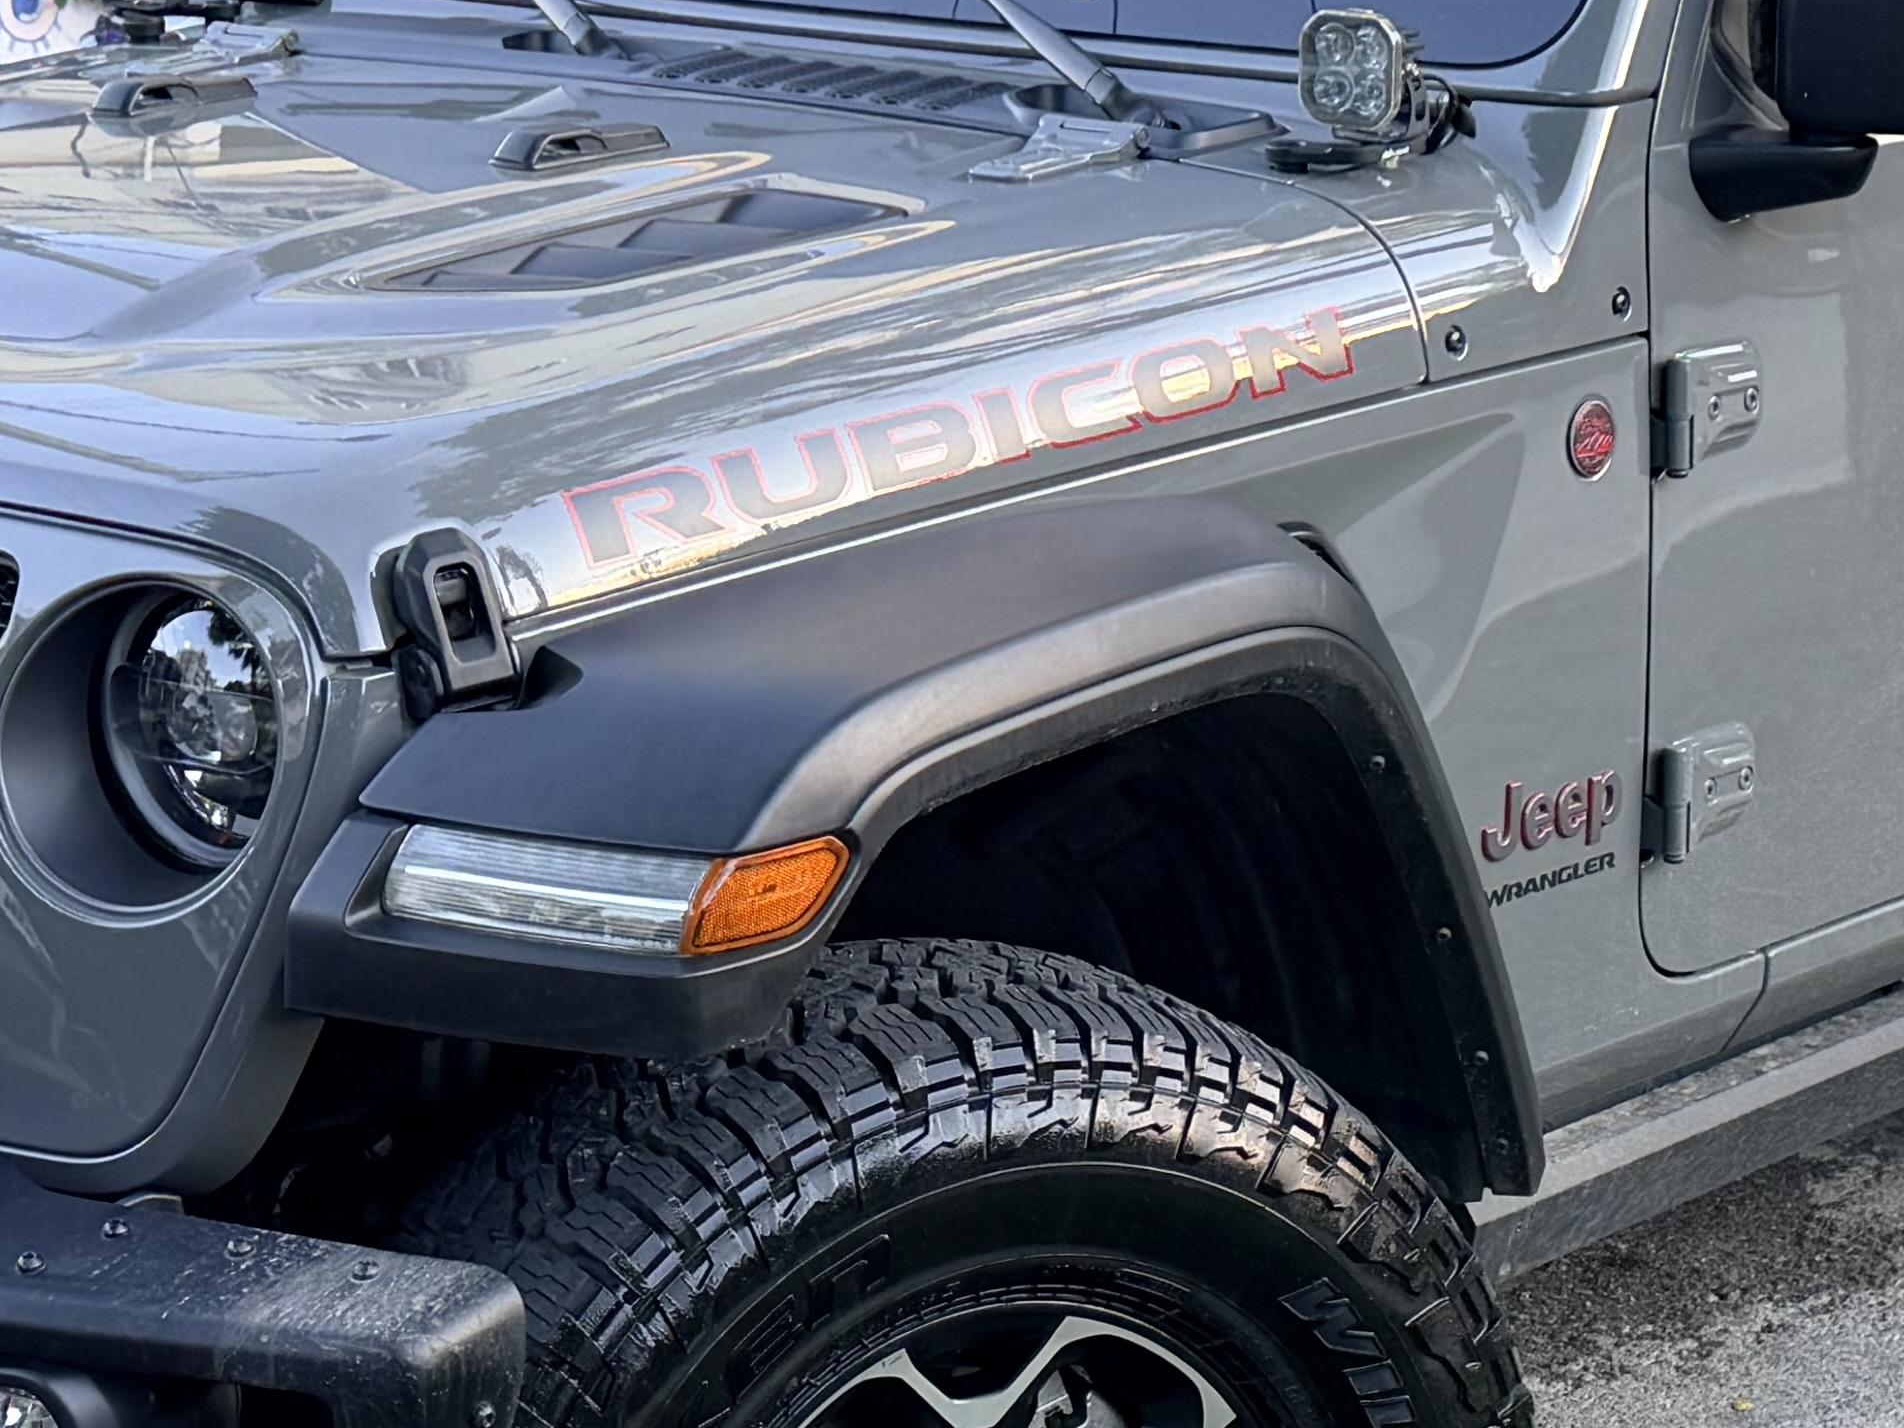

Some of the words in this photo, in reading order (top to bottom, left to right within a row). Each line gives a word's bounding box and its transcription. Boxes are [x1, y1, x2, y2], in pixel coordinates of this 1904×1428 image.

[561, 306, 1356, 571] RUBICON
[1481, 768, 1623, 863] Jeep
[1485, 851, 1616, 909] WRANGLER
